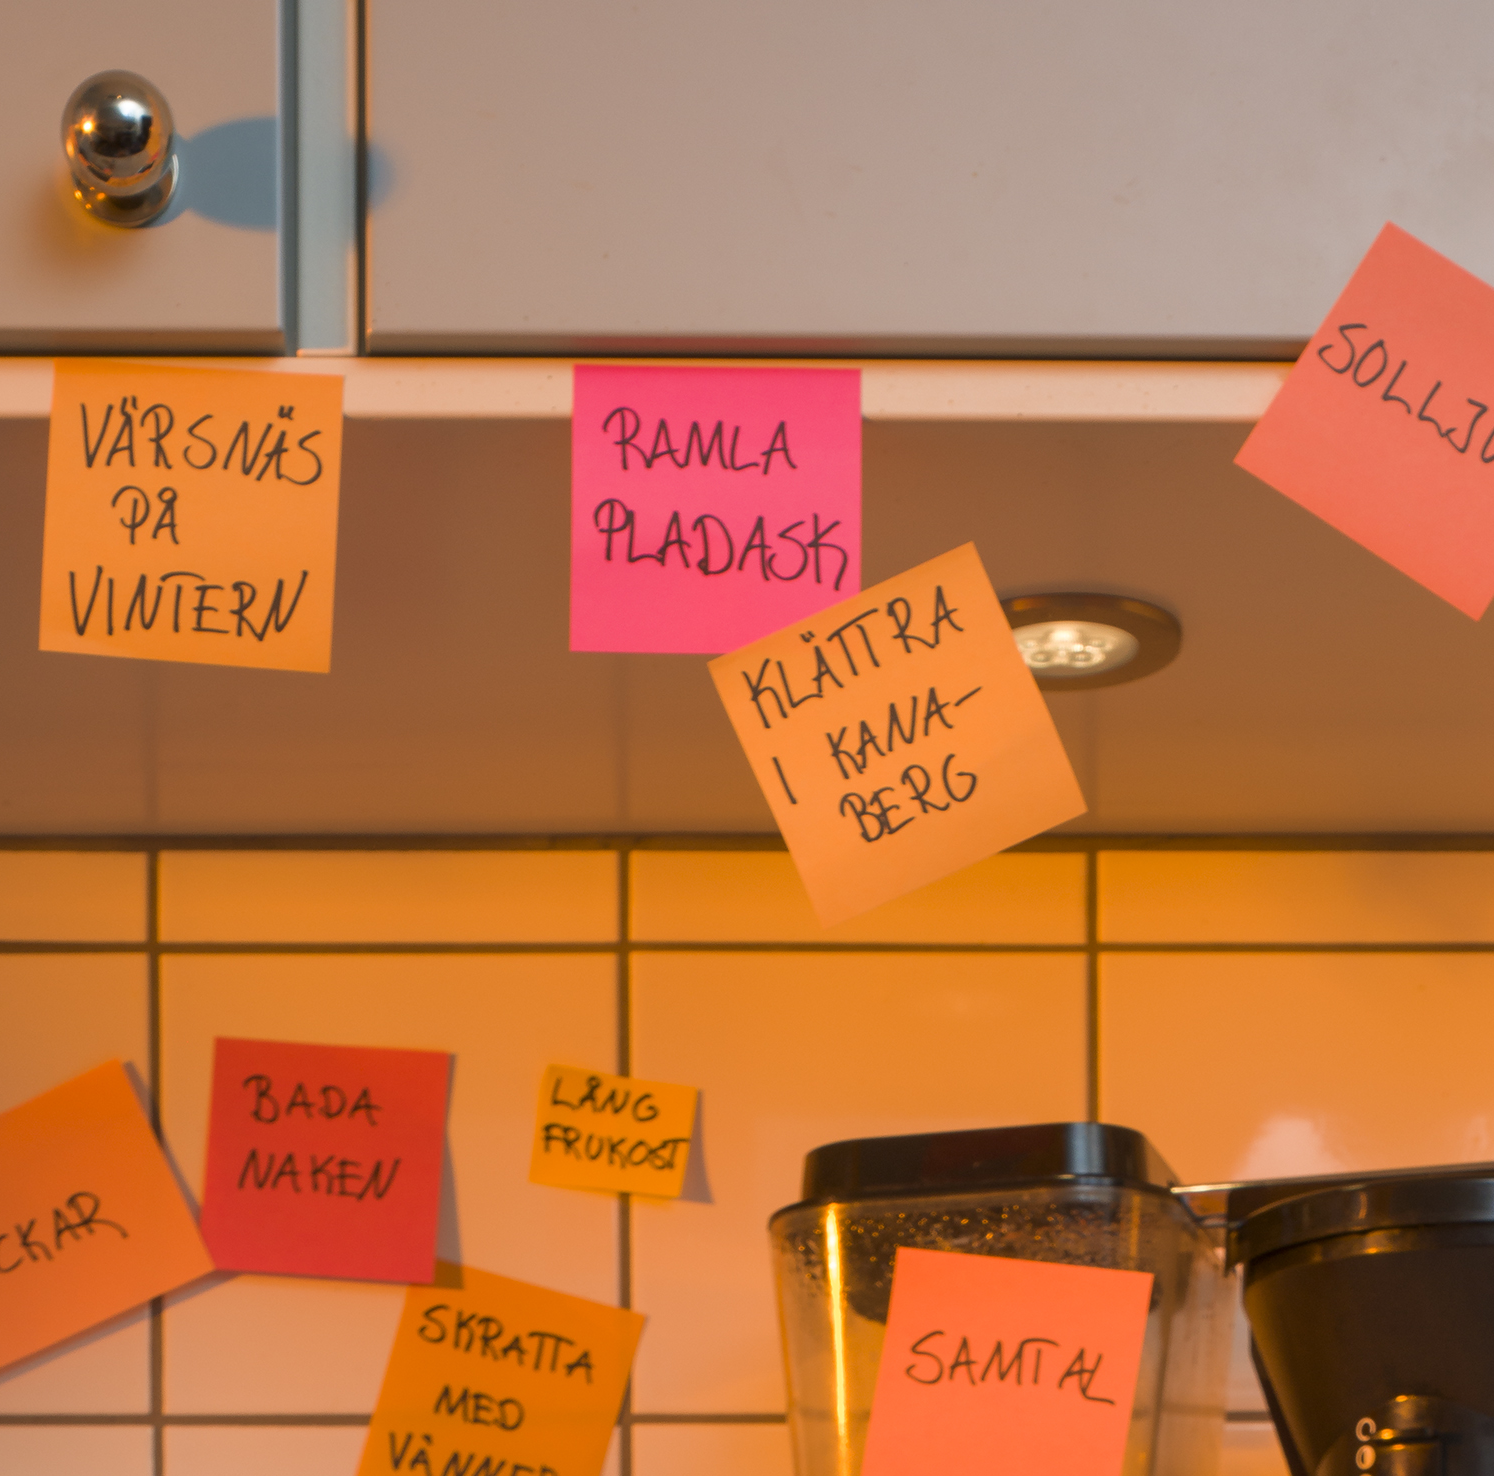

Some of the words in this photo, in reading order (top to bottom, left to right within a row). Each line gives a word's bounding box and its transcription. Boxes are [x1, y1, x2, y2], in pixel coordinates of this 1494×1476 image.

[81, 395, 323, 486] VÄRSNÄS
[603, 407, 797, 475] RAMLA
[111, 485, 179, 545] PÅ
[593, 498, 848, 591] PLADASK
[69, 565, 308, 642] VINTERN
[742, 585, 964, 729] KLÄTTRA
[772, 756, 797, 805] I
[839, 753, 977, 843] BERG
[242, 1074, 382, 1126] BADA
[551, 1075, 659, 1123] LÅNG
[237, 1148, 401, 1201] NAKEN
[542, 1122, 692, 1171] FRUKOST
[418, 1304, 593, 1383] SKRATTA
[905, 1330, 1115, 1405] SAMTAL
[433, 1384, 525, 1431] MED
